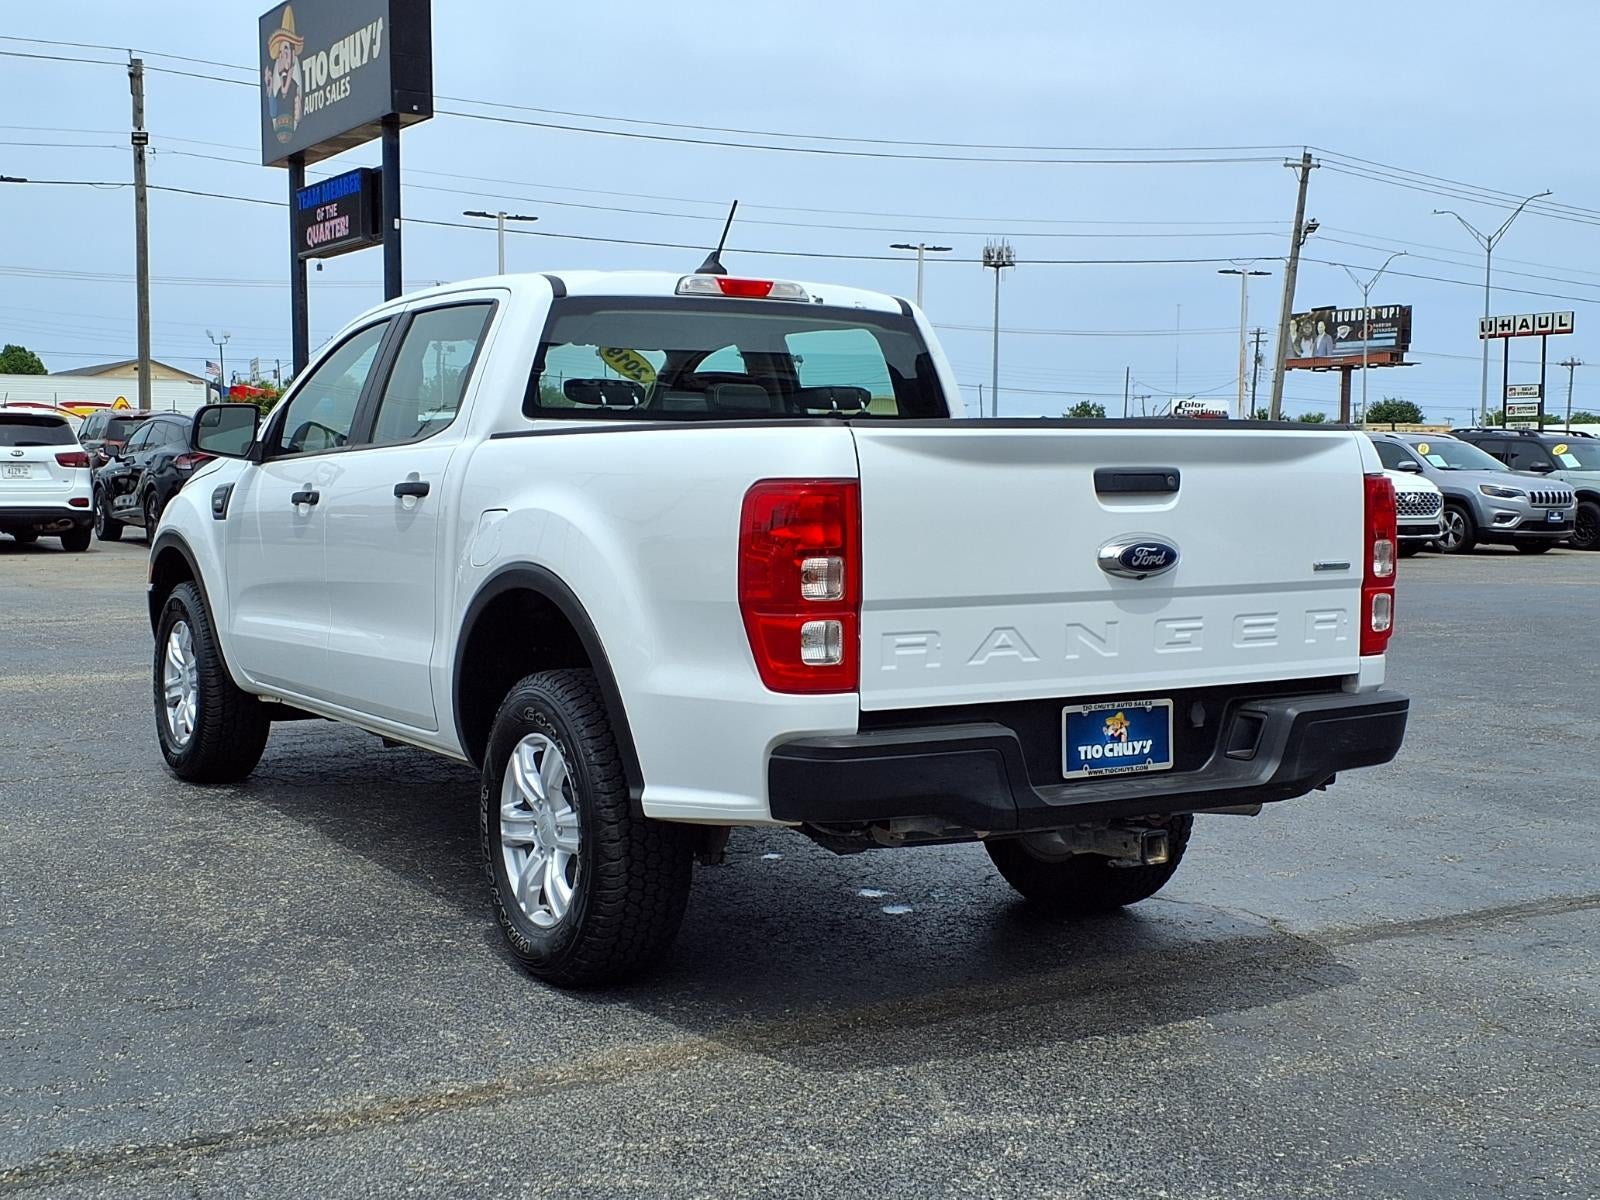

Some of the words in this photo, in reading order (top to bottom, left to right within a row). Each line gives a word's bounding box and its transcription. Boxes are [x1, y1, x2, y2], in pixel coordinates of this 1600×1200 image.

[303, 51, 328, 93] TIO
[329, 17, 384, 79] CHUY'S
[304, 91, 325, 116] AUTO
[326, 76, 351, 106] SALES
[297, 185, 320, 211] TEAM
[321, 172, 361, 203] MEMBER
[316, 206, 324, 221] OF
[325, 203, 338, 219] THE
[306, 215, 349, 248] QUARTER!
[1331, 307, 1376, 323] THUNDER
[1382, 306, 1400, 319] UP!
[1178, 401, 1206, 409] Color
[1131, 546, 1166, 567] Ford
[881, 608, 1348, 671] RANGER
[1078, 745, 1103, 760] TIO
[1104, 739, 1152, 757] CHUY'S
[1088, 765, 1149, 776] WWW.TIOCHUYS.COM
